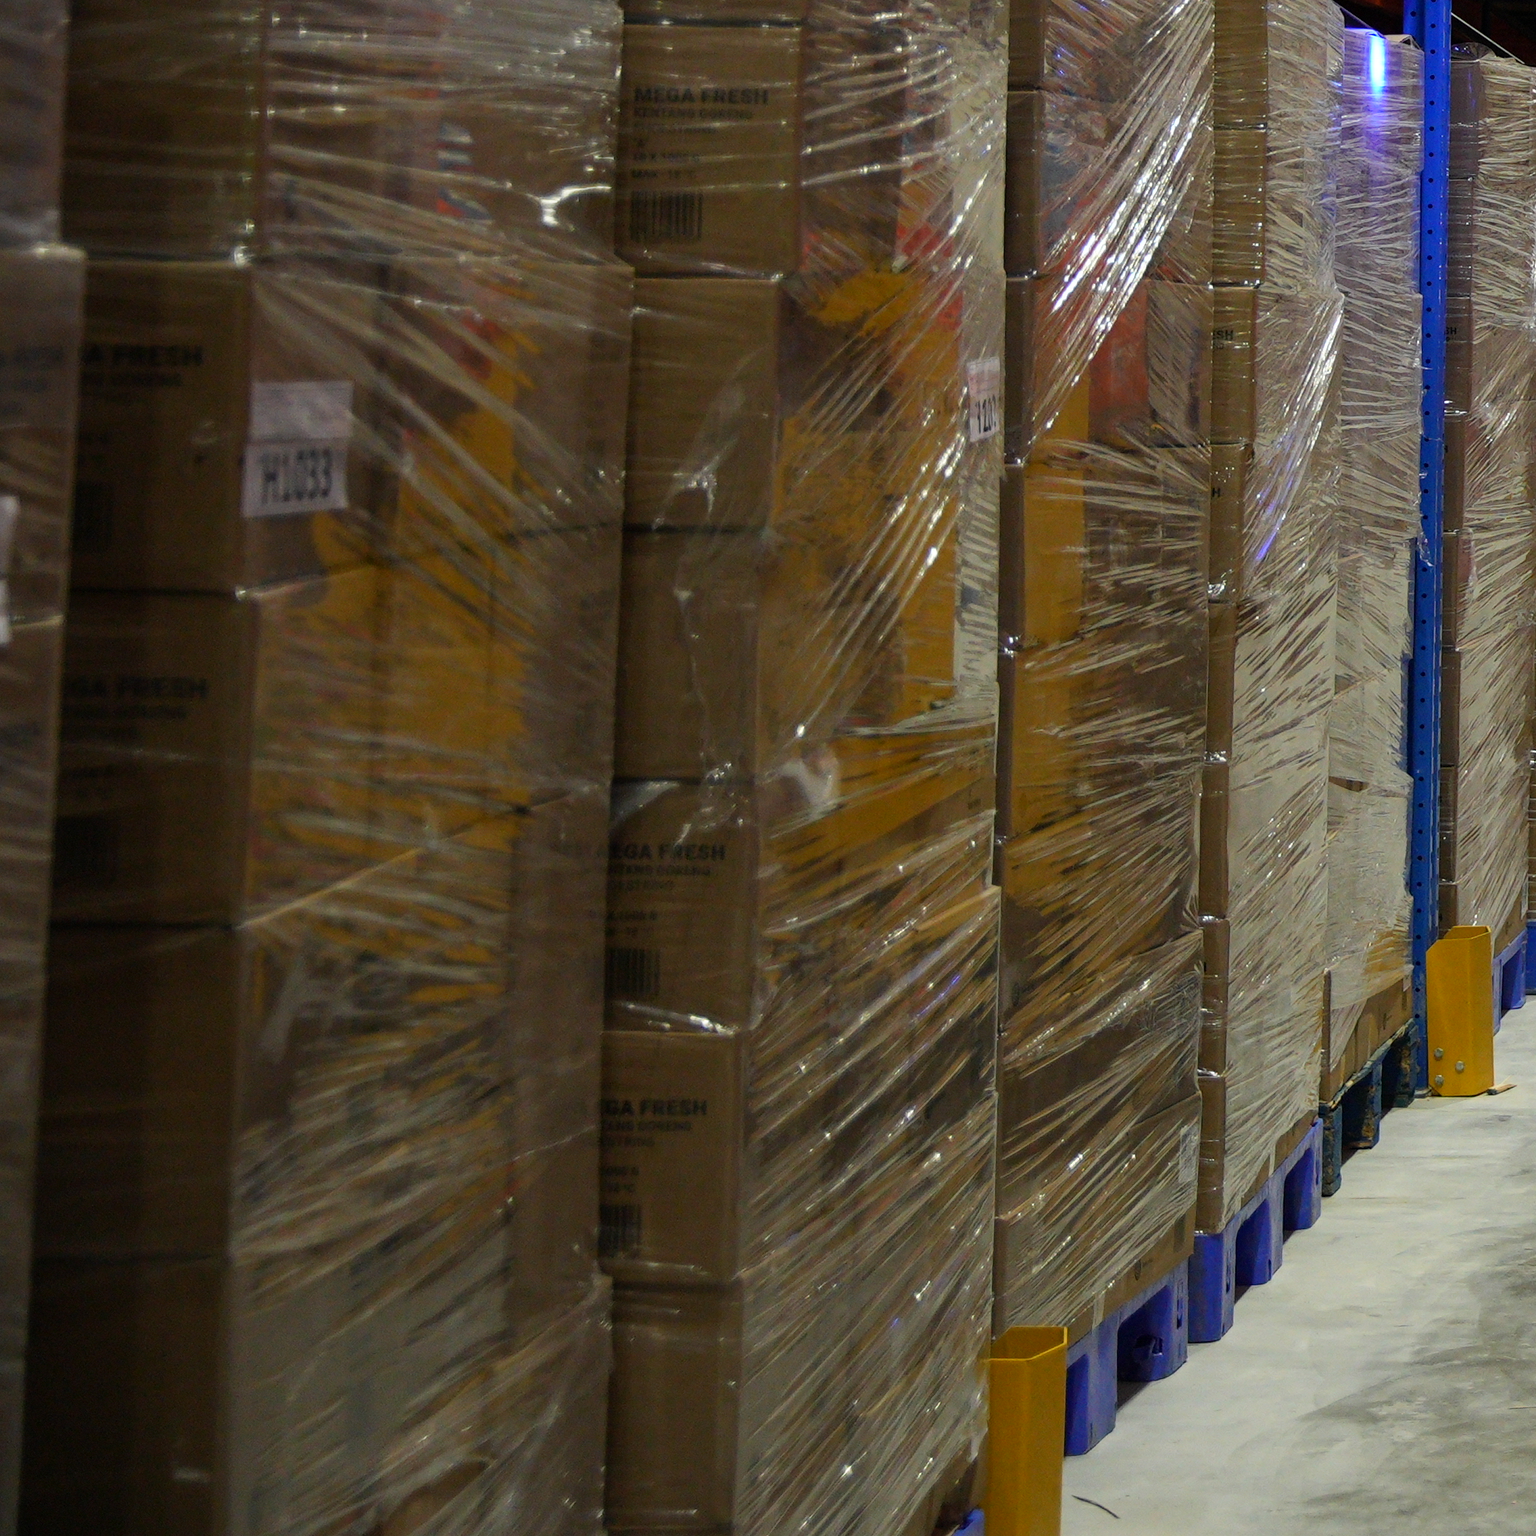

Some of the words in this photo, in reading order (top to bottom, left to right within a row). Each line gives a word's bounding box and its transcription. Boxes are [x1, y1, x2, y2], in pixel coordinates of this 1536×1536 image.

[634, 86, 696, 104] MEGA
[700, 87, 769, 105] FRESH
[658, 844, 726, 861] FRESH
[639, 1098, 708, 1116] FRESH
